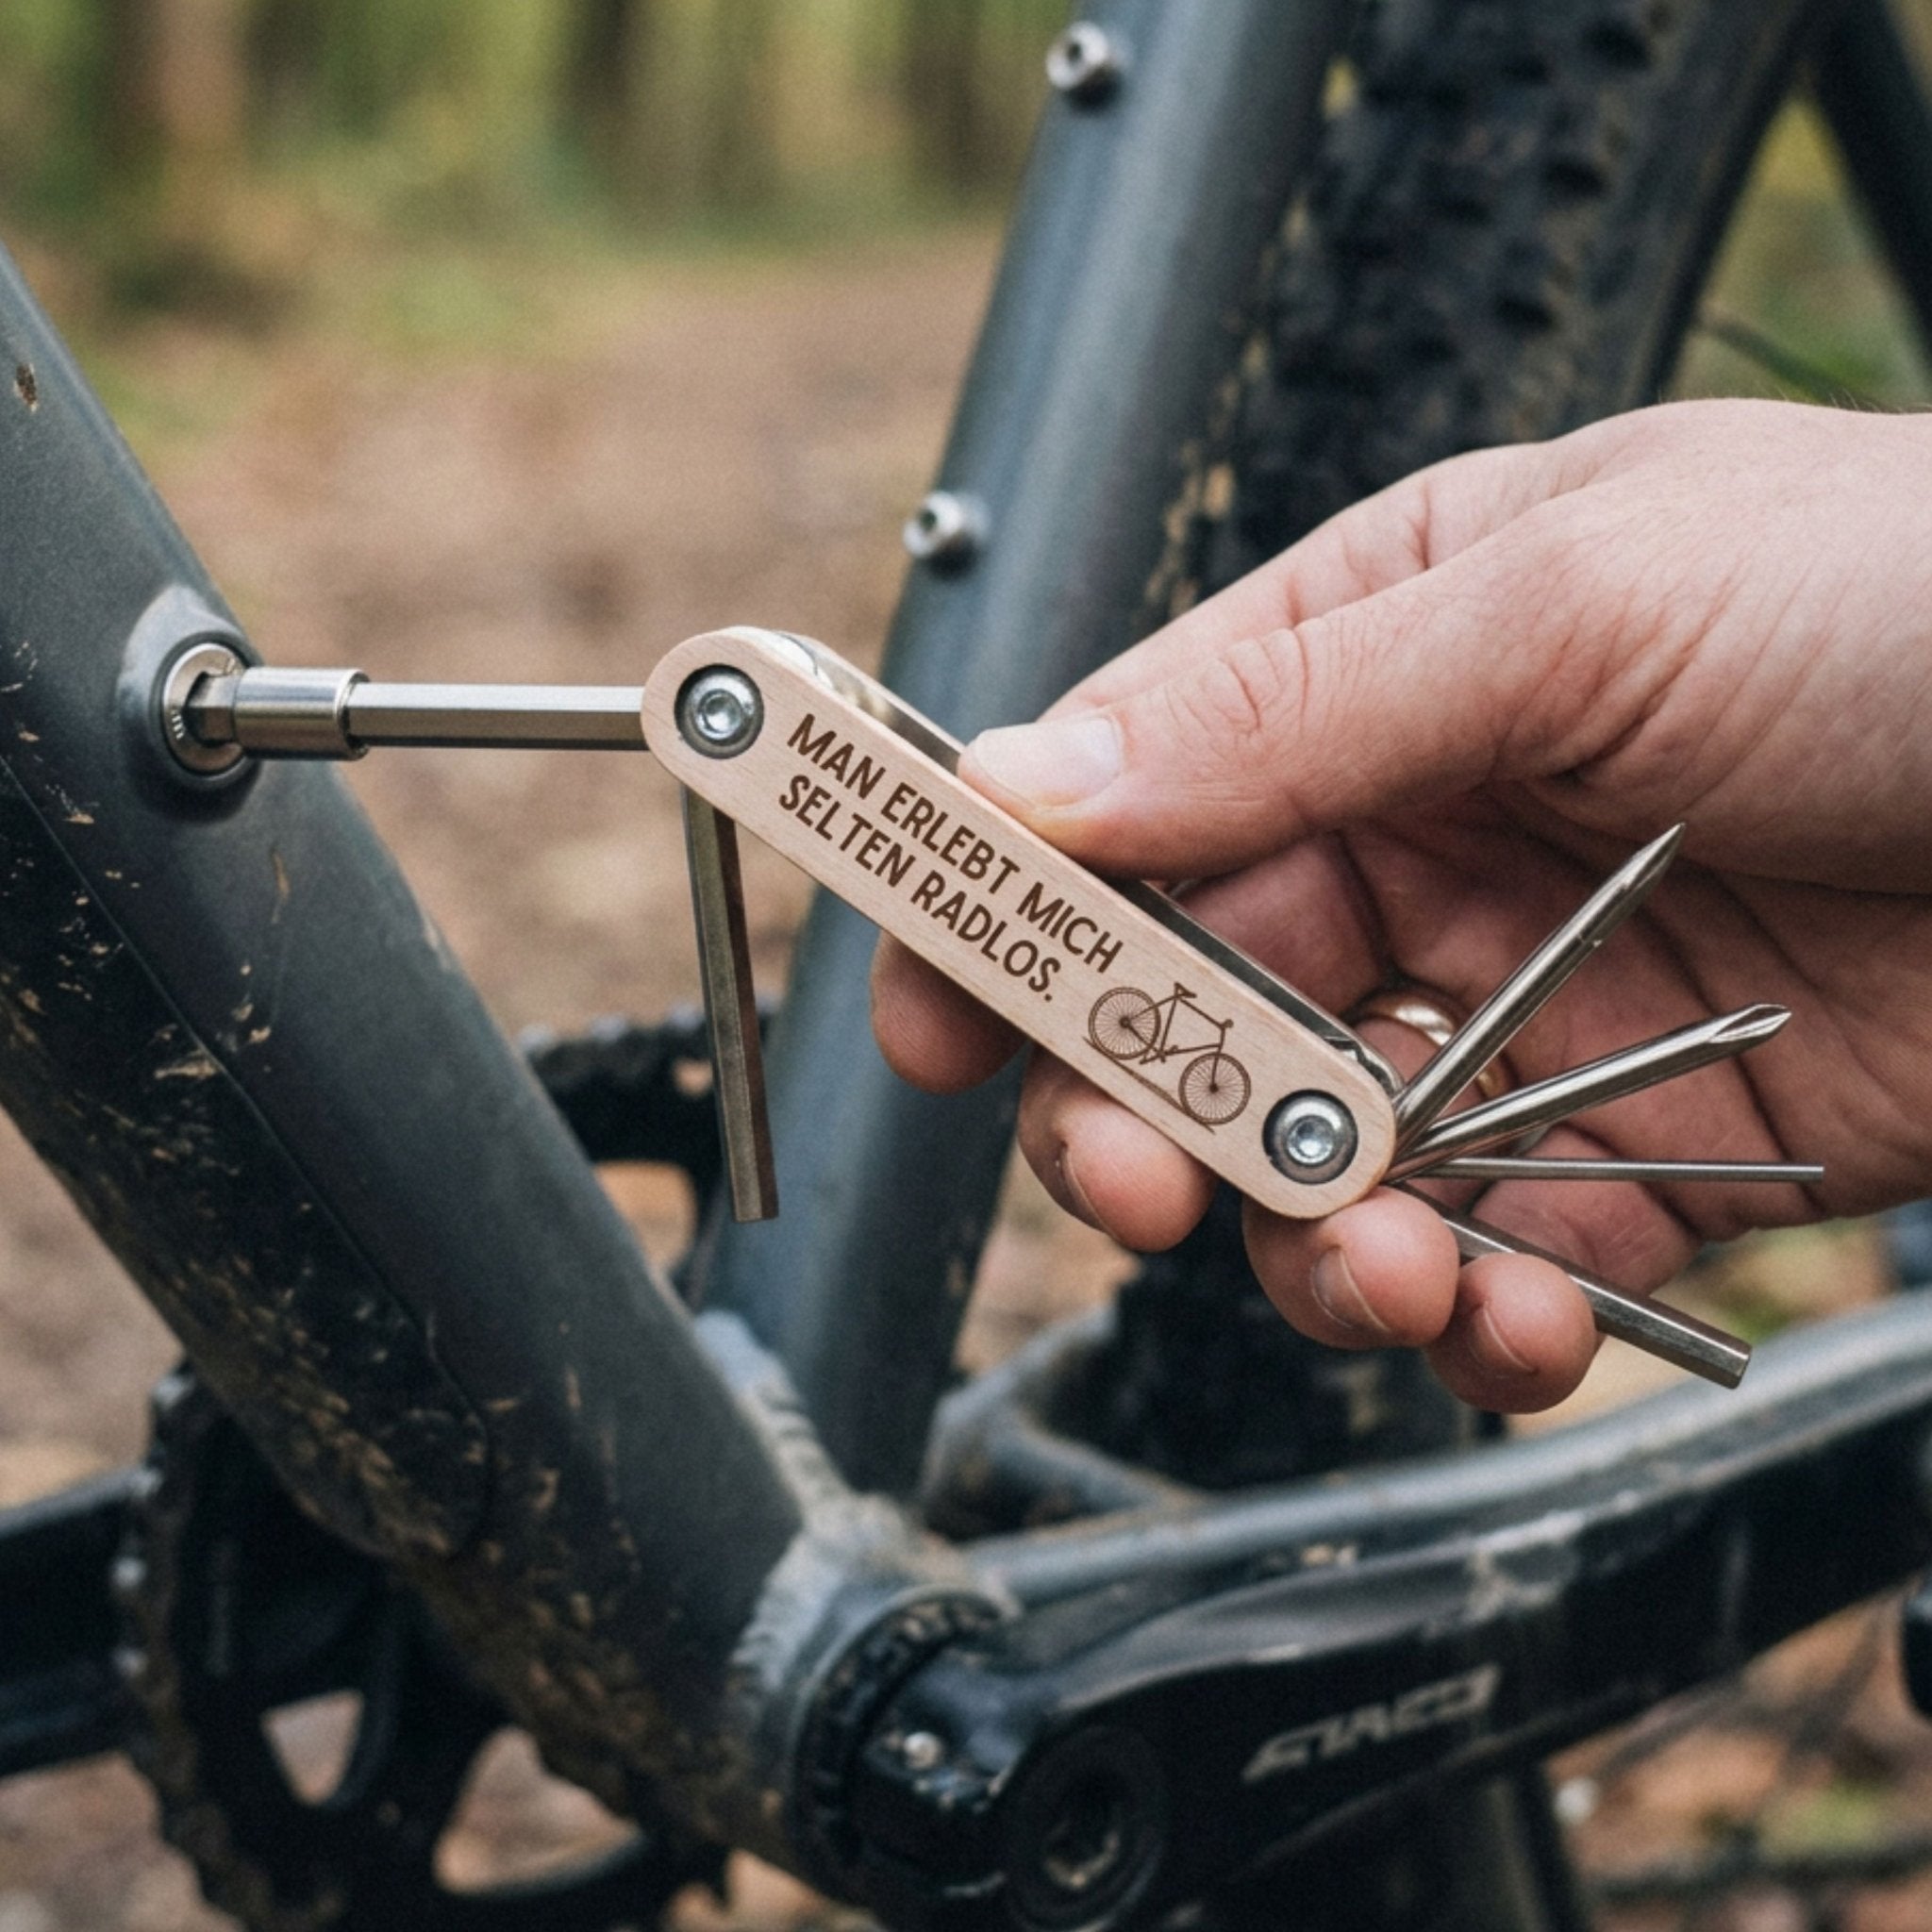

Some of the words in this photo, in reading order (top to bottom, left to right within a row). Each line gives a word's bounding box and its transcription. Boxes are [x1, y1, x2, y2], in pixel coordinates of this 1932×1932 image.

[779, 774, 917, 887] SELTEN
[910, 870, 1061, 1002] RADLOS.
[787, 713, 886, 799] MAN
[881, 782, 1021, 894] ERLEBT
[1015, 882, 1124, 974] MICH
